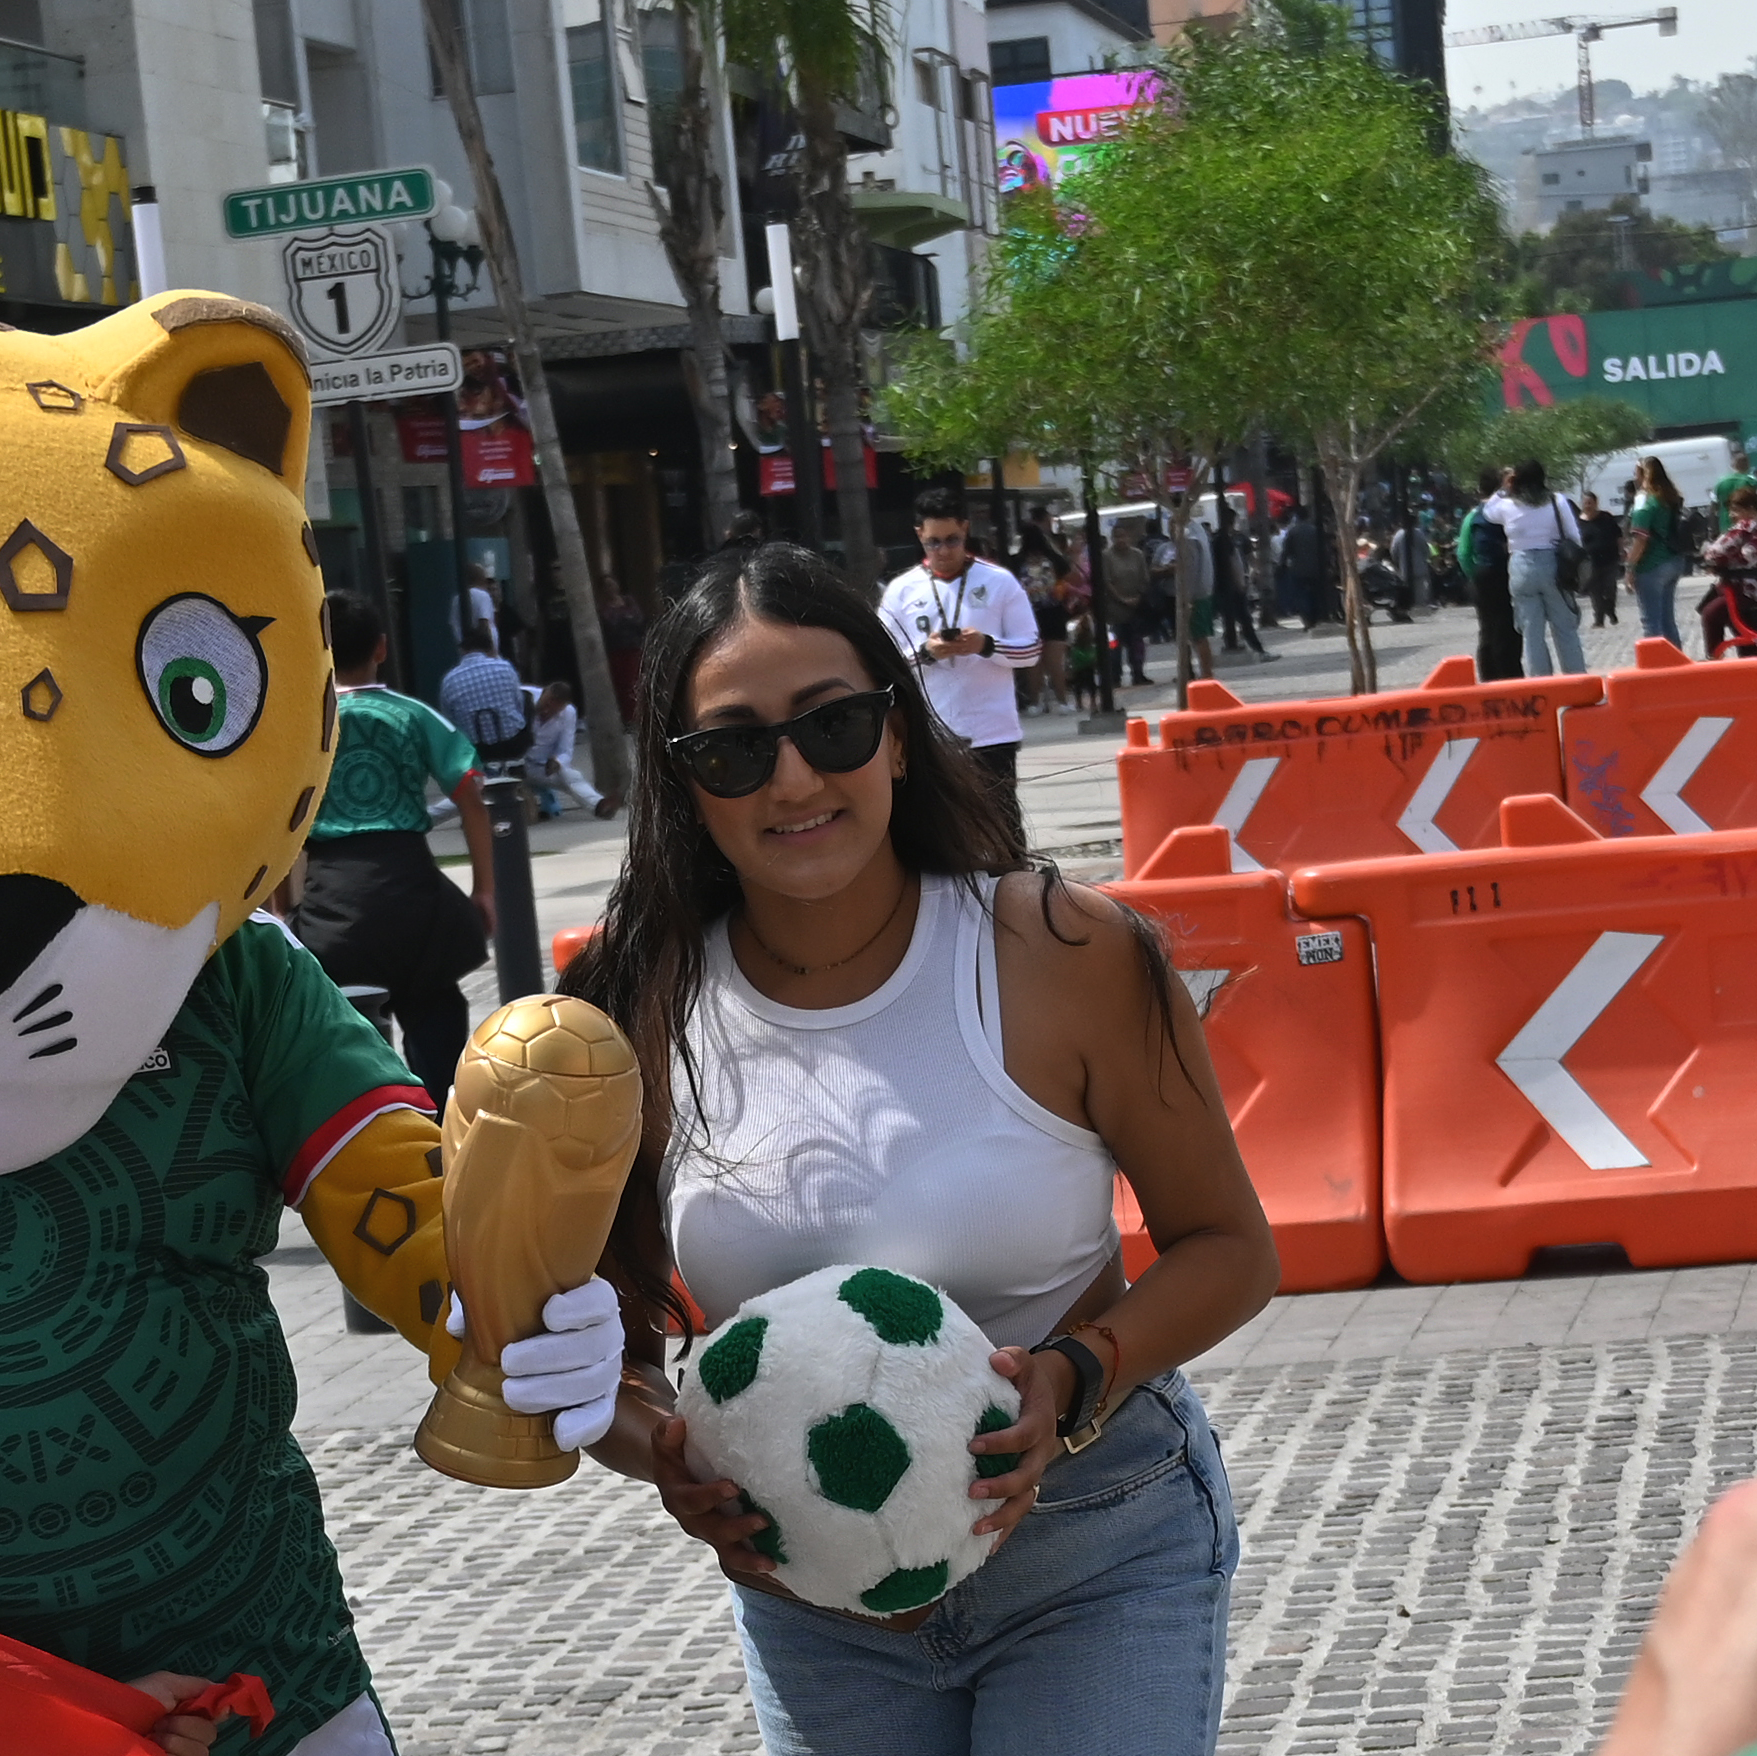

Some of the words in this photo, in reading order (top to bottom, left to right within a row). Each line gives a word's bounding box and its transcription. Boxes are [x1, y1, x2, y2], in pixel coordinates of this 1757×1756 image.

[241, 180, 414, 228] TIJUANA
[301, 249, 372, 276] MÉXICO
[327, 281, 350, 335] 1
[366, 363, 383, 387] la
[390, 360, 450, 384] Patria
[1602, 350, 1726, 384] SALIDA
